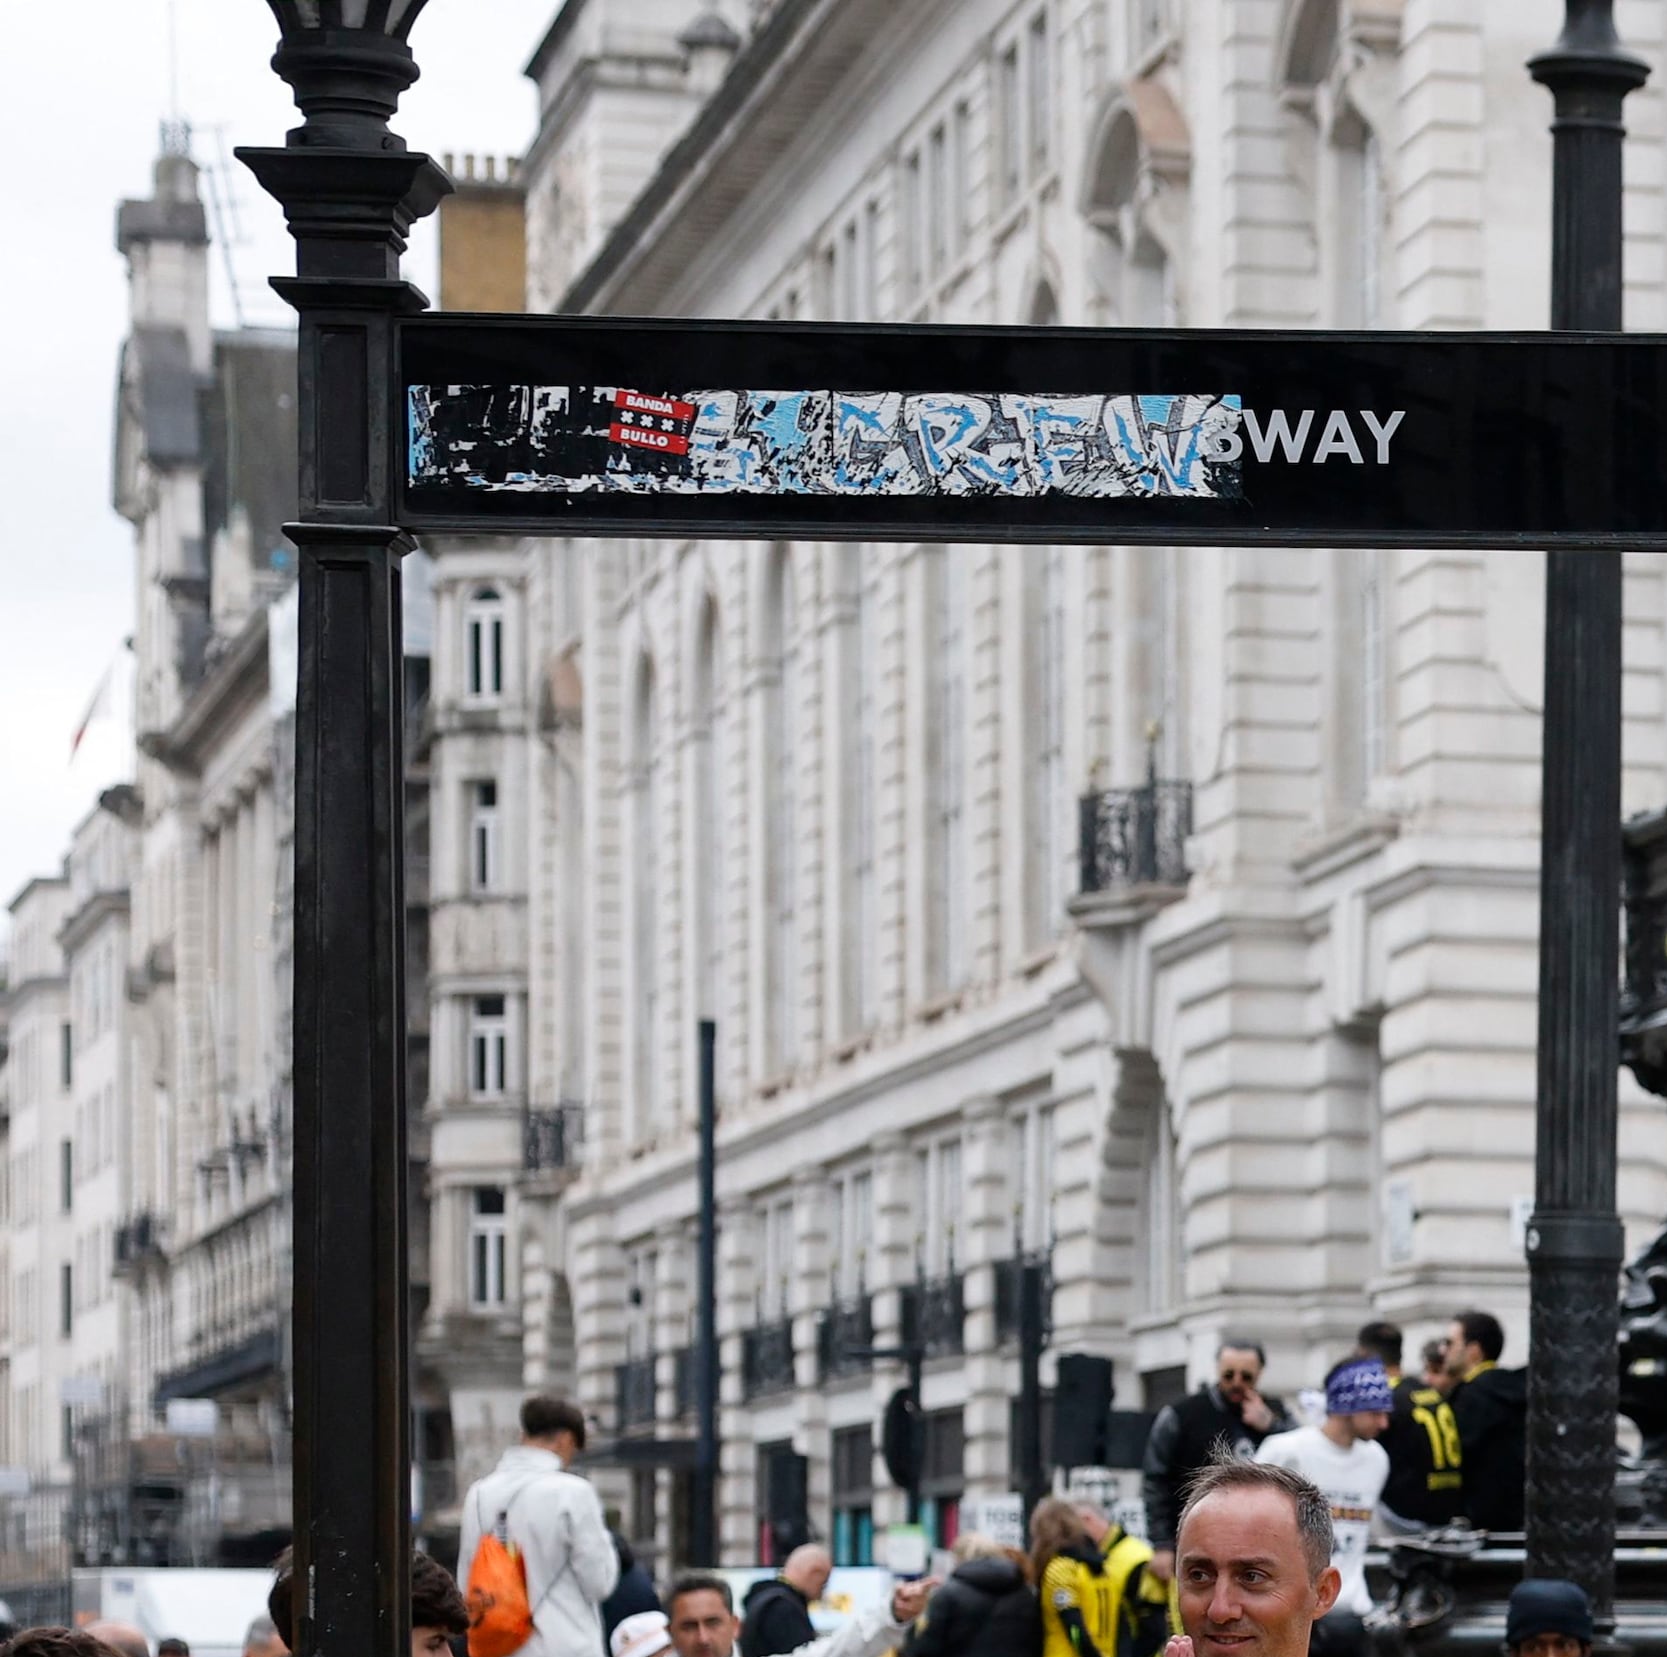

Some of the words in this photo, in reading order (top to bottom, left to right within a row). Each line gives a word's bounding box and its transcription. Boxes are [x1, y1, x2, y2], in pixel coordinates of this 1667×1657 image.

[625, 395, 674, 414] BANDA
[619, 428, 670, 448] BULLO
[1206, 409, 1406, 464] BWAY
